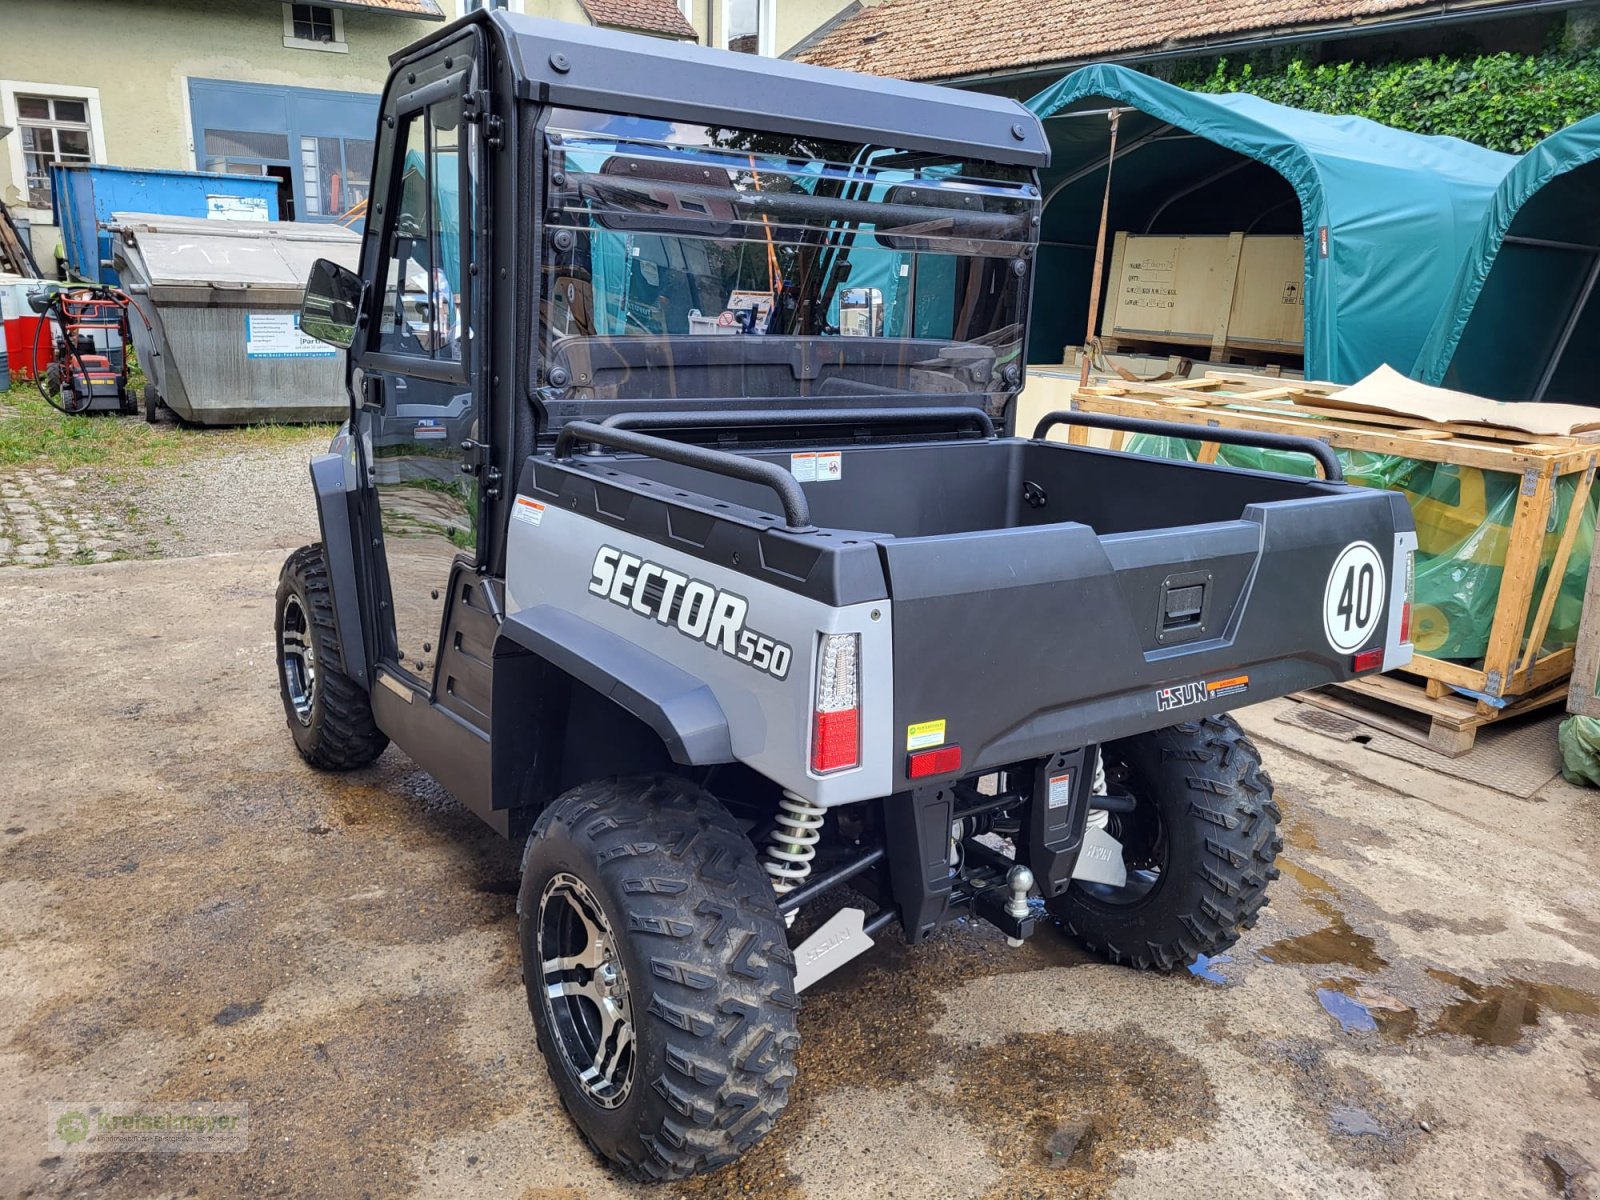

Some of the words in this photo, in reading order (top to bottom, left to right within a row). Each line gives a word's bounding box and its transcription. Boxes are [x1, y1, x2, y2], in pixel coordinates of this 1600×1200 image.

[588, 544, 748, 656] SECTOR
[737, 629, 792, 679] 550
[1337, 562, 1374, 632] 40
